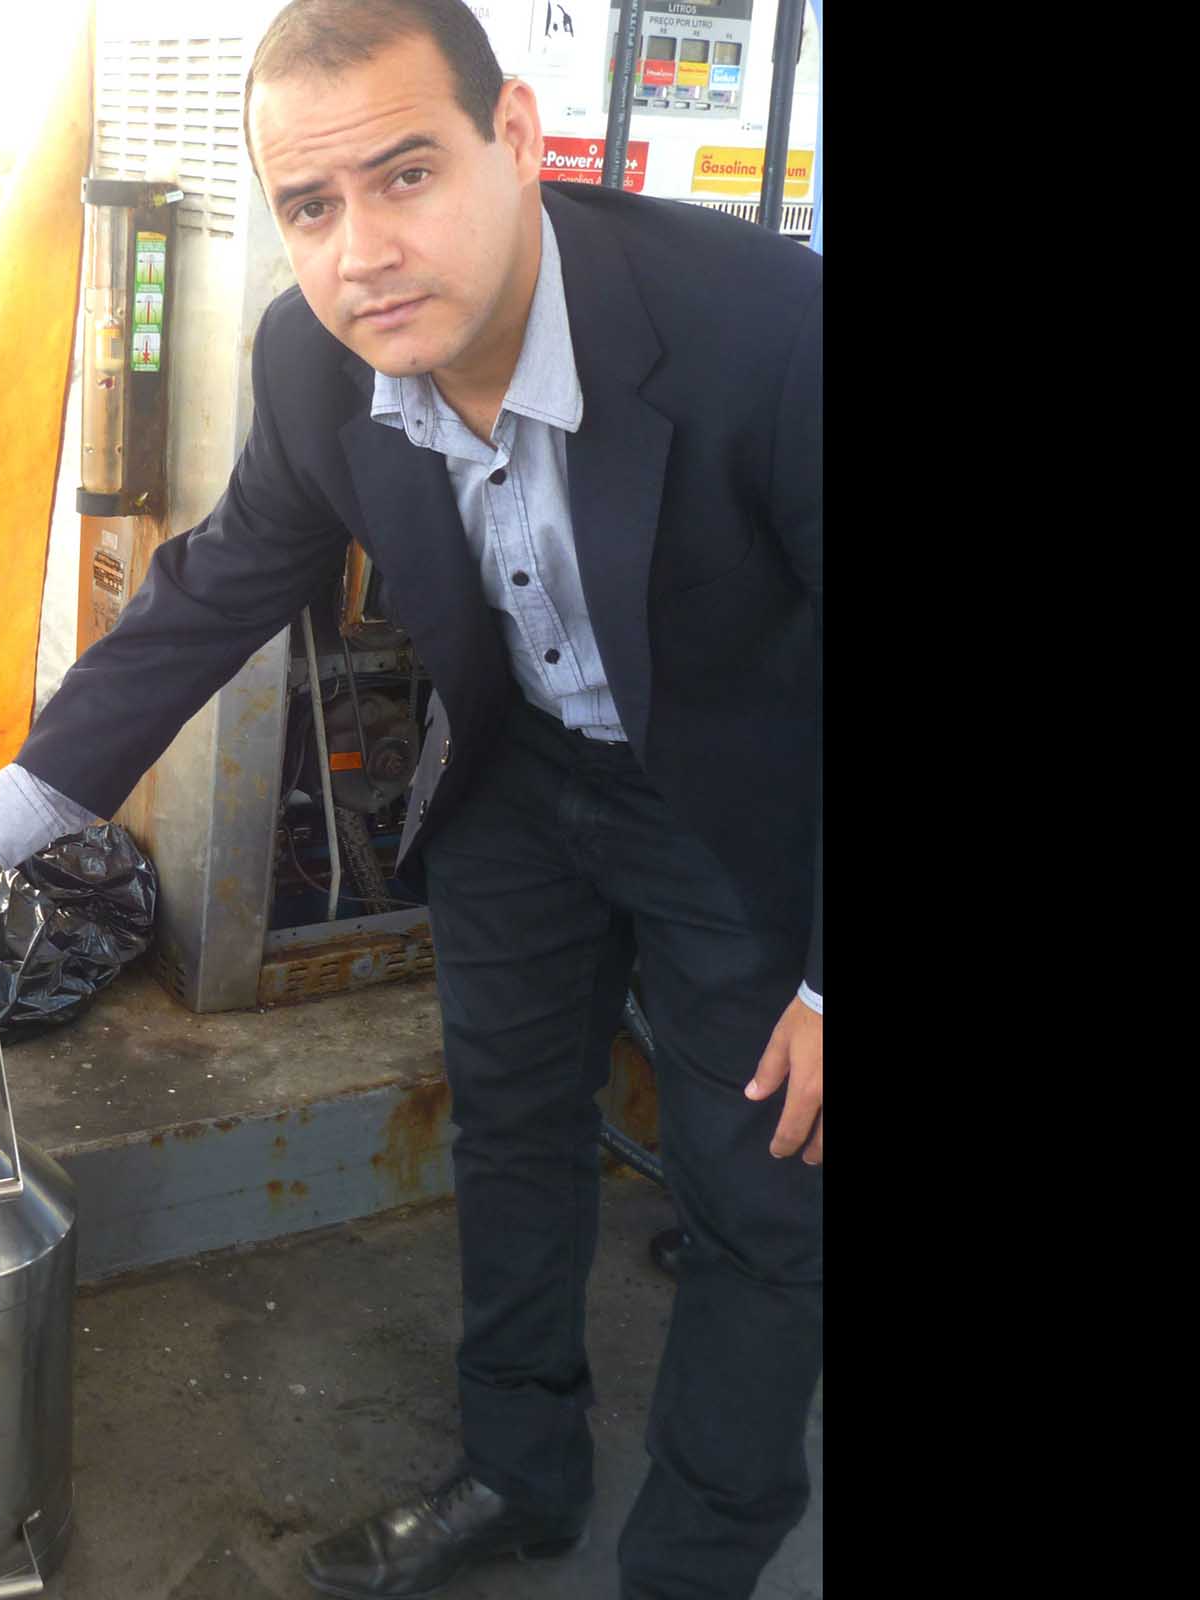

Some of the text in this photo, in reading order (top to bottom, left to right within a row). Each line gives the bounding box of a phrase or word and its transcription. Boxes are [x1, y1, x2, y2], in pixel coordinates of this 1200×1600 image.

[668, 3, 697, 14] LITROS
[542, 150, 594, 168] -Power
[701, 160, 757, 175] Gasolina
